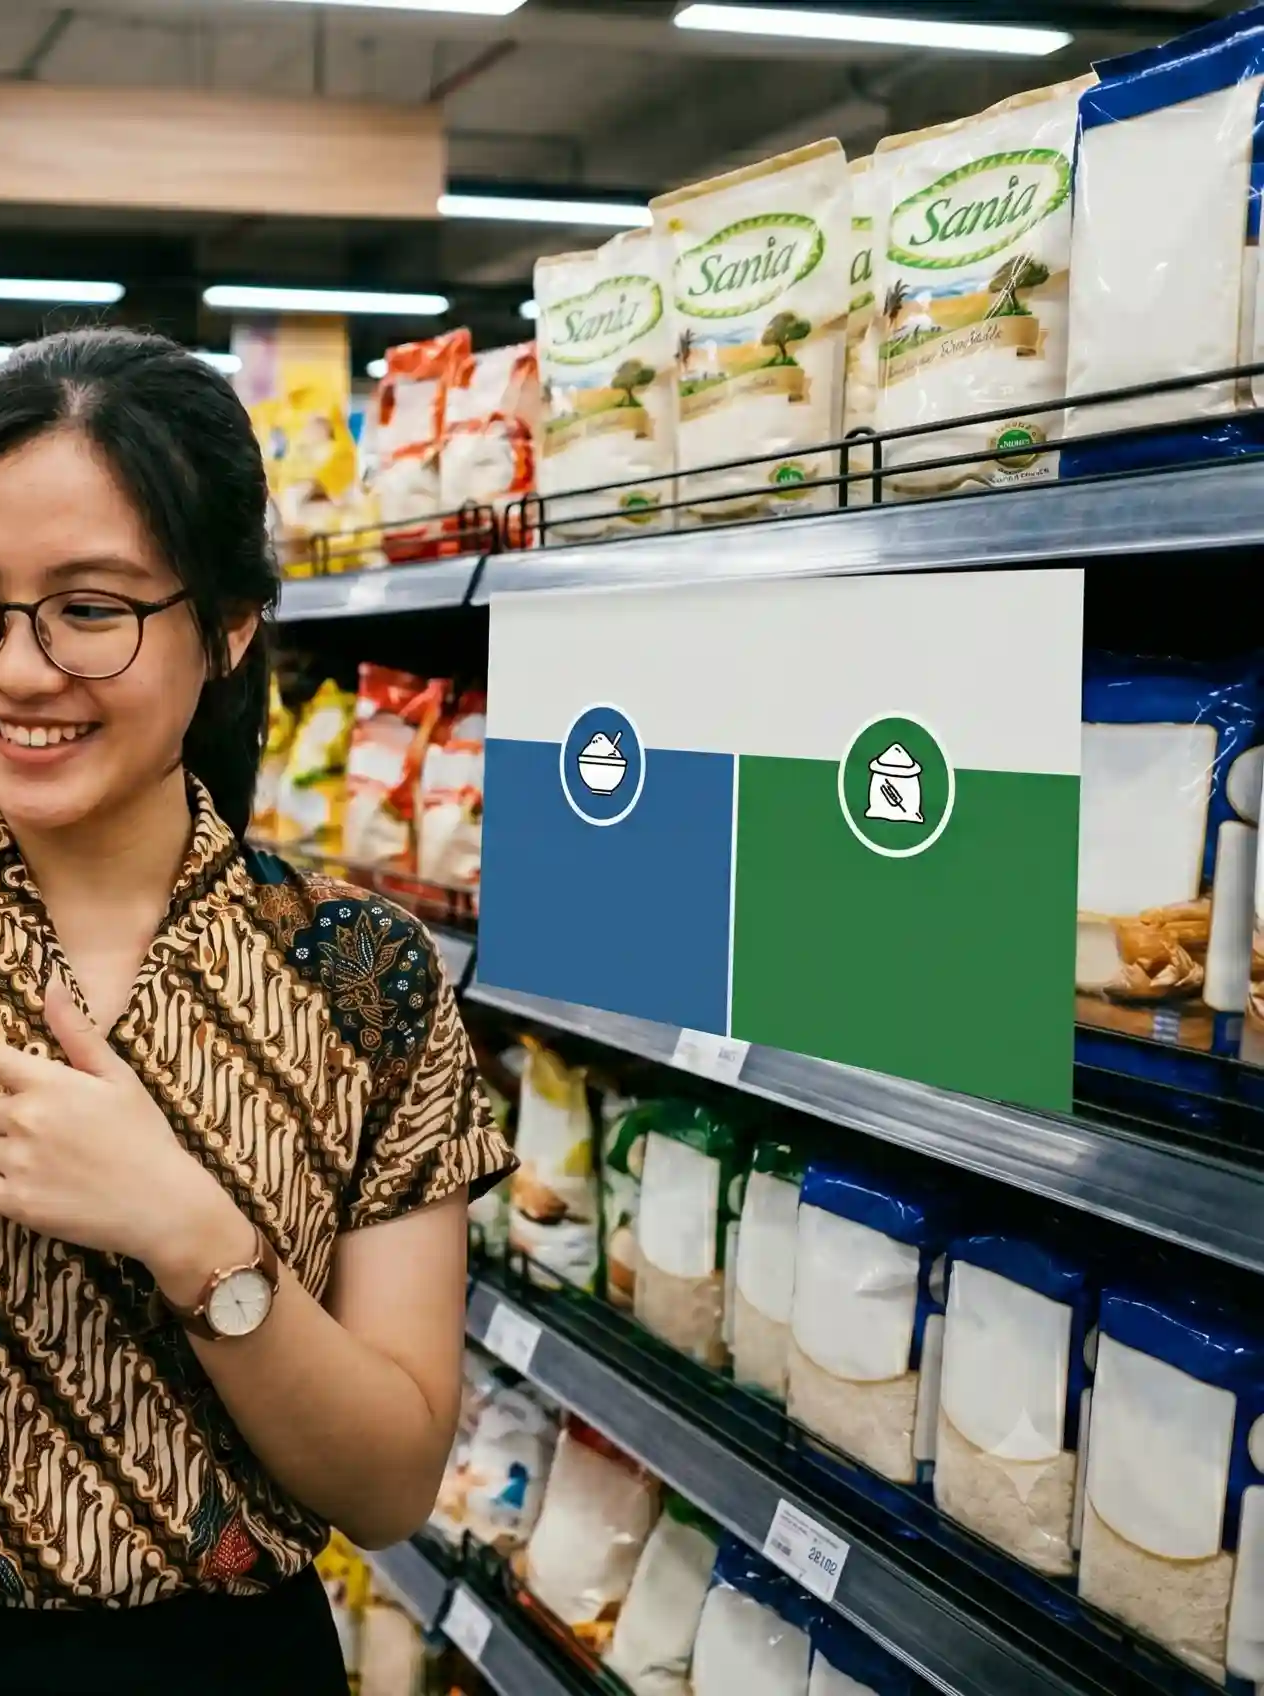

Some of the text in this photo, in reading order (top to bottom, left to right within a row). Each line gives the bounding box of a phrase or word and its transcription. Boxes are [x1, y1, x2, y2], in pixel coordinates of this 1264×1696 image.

[908, 174, 1040, 246] Sania
[688, 235, 798, 296] Sania
[552, 292, 640, 346] Sania
